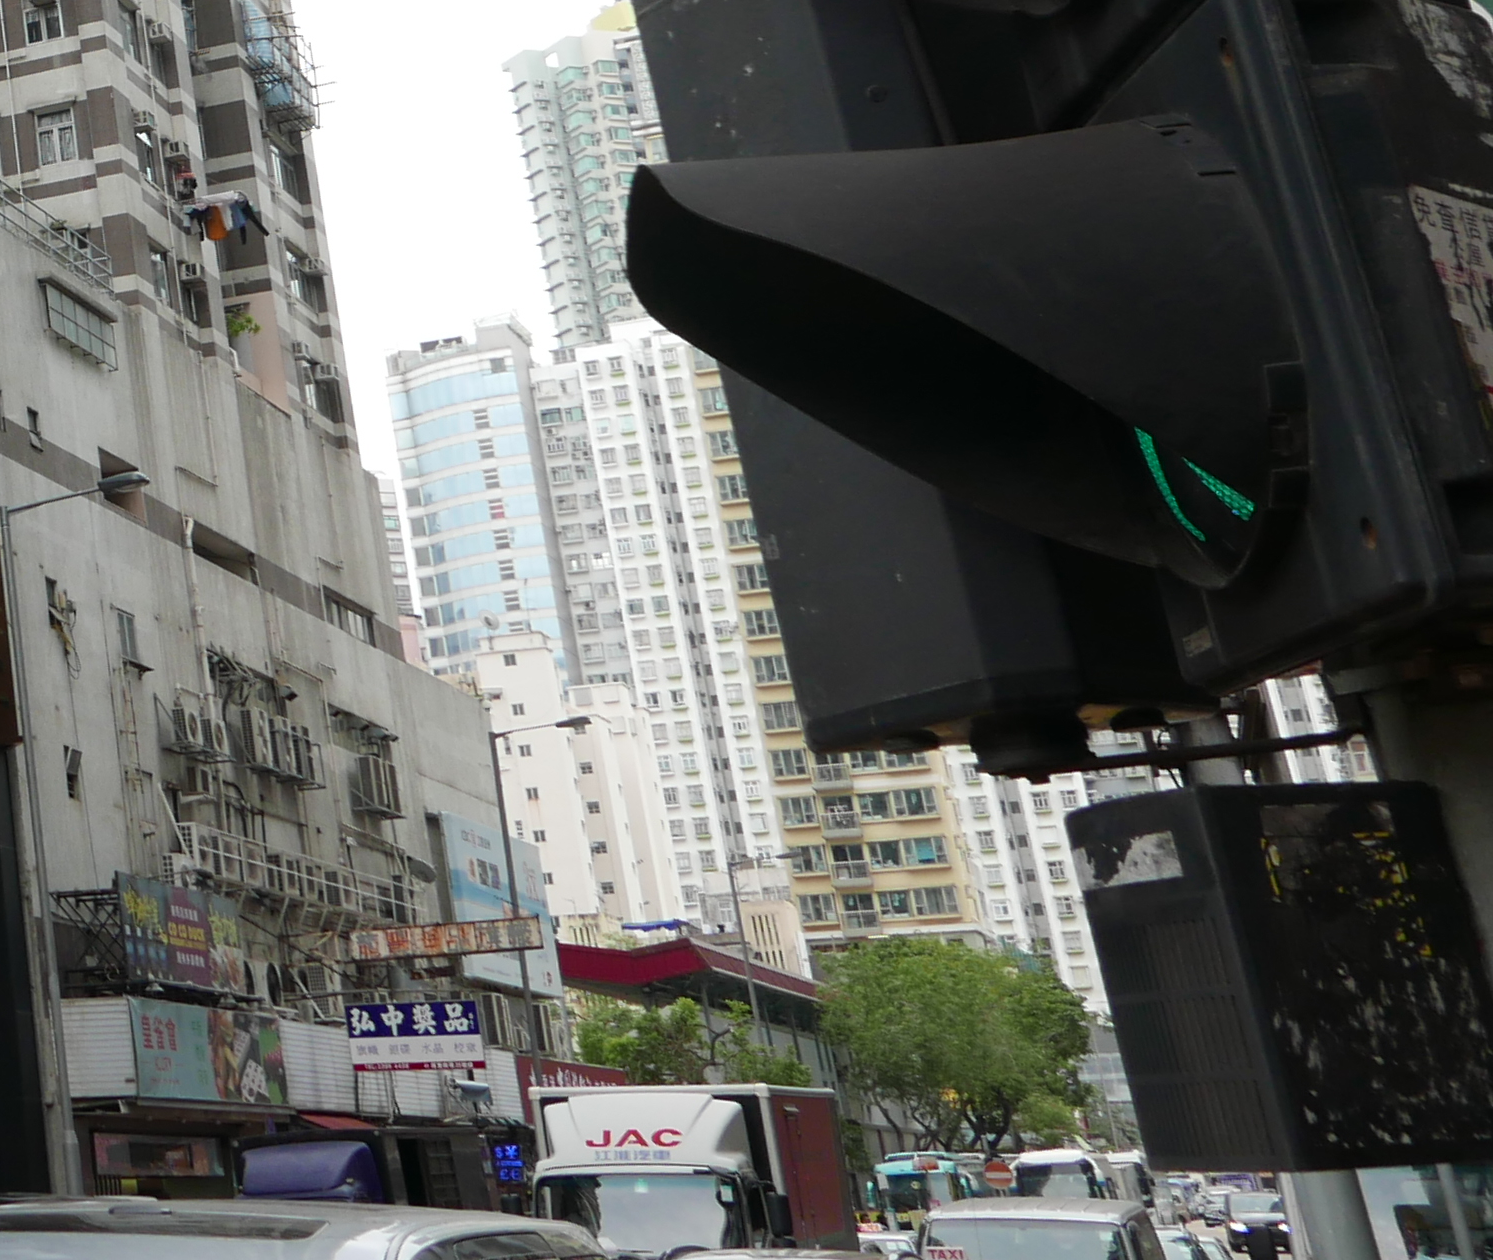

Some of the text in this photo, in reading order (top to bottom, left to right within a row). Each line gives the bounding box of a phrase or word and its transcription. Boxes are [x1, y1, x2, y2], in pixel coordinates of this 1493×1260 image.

[350, 1002, 469, 1037] 弘中獎品
[422, 1042, 444, 1055] 水晶
[585, 1128, 683, 1148] JAC
[927, 1249, 964, 1260] TAXI
